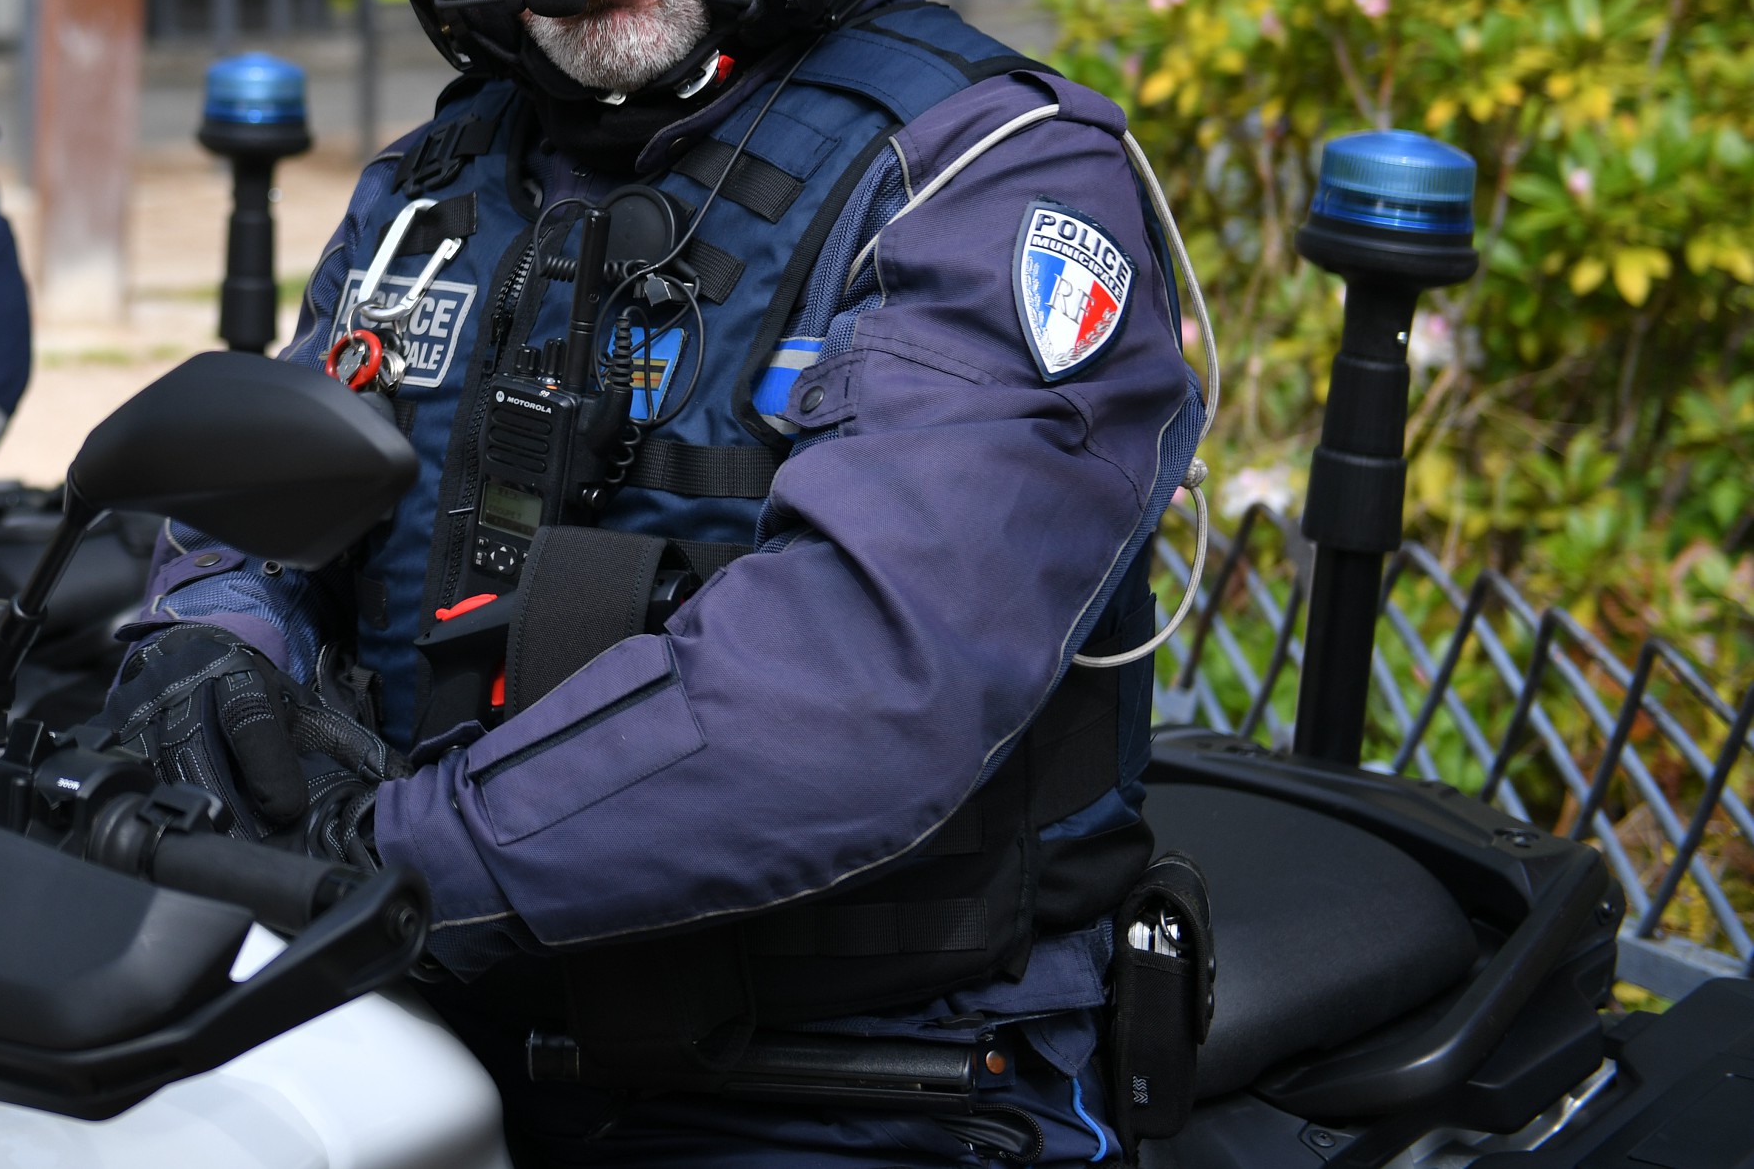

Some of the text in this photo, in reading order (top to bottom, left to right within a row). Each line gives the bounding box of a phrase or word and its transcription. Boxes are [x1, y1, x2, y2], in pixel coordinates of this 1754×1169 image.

[1032, 234, 1124, 302] MUNICIPALE
[1034, 213, 1129, 288] POLICE
[507, 396, 552, 414] MOTOROLA
